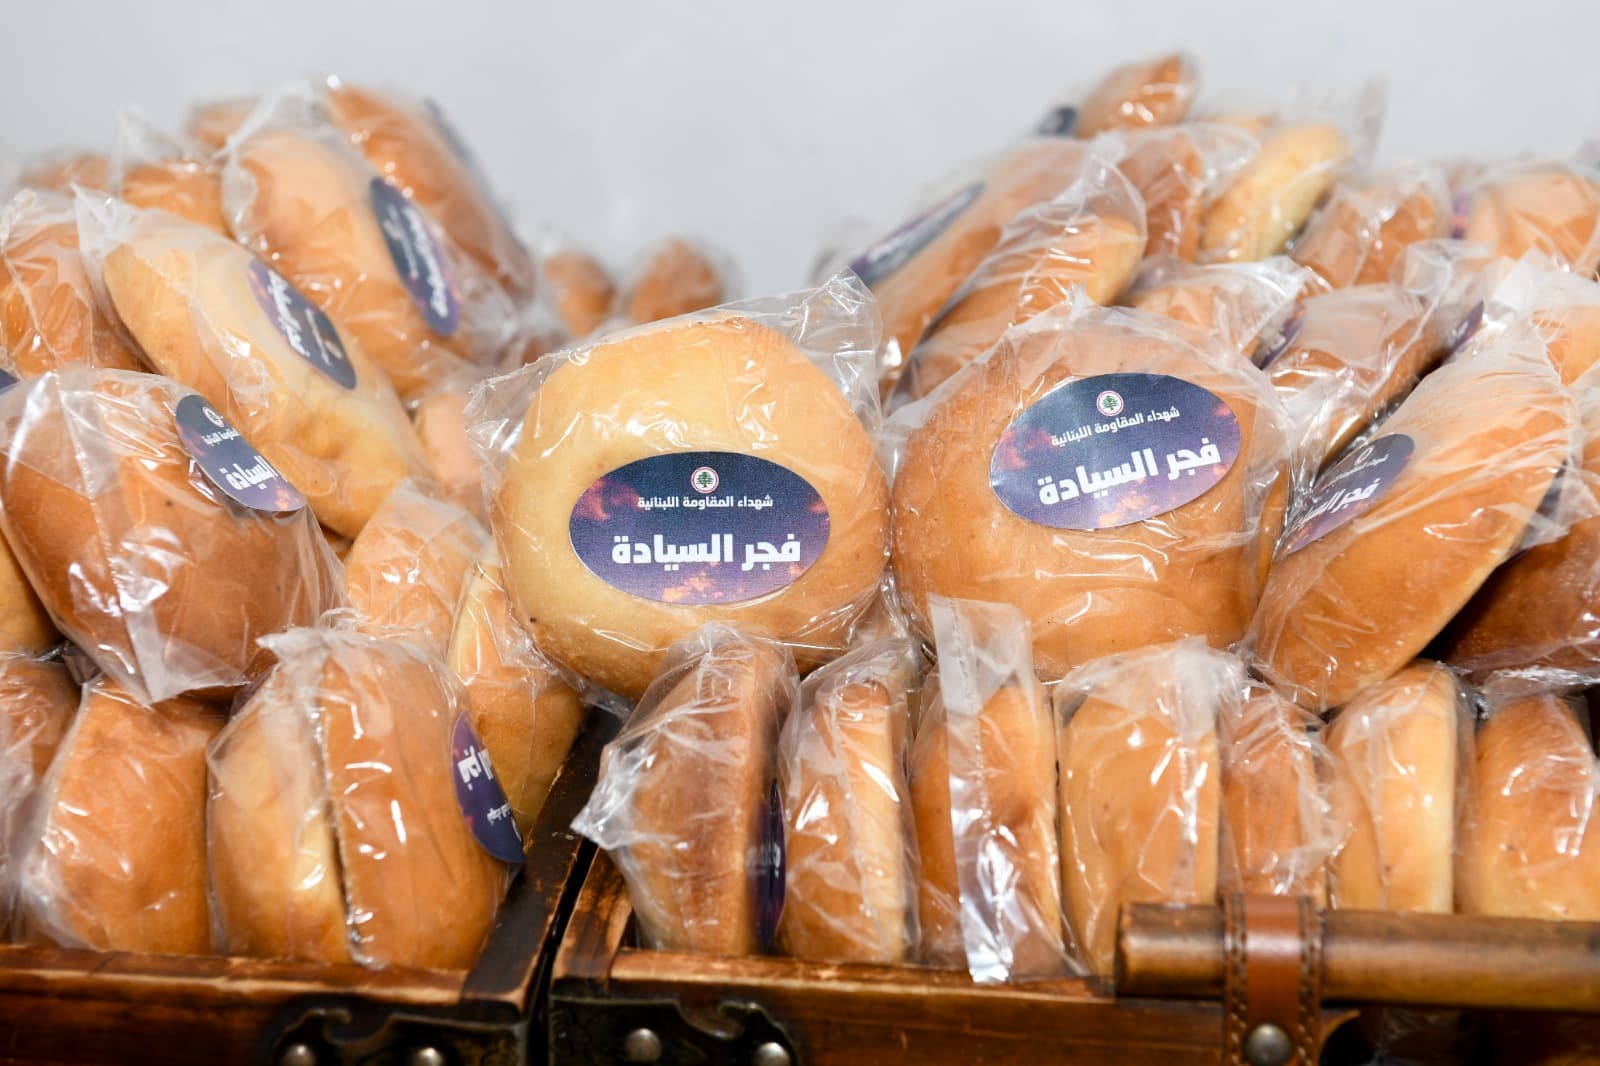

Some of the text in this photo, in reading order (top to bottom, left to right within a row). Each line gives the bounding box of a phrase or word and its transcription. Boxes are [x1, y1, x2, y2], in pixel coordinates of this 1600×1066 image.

[1051, 406, 1180, 447] شهداء المقاومة اللبنانية
[218, 455, 279, 491] السيادة
[1038, 437, 1221, 506] فجر السيادة
[638, 494, 773, 511] شهداء المقاومة اللبنانية
[1330, 477, 1381, 514] فجر
[612, 533, 801, 572] فجر السيادة
[457, 745, 482, 791] فجر
